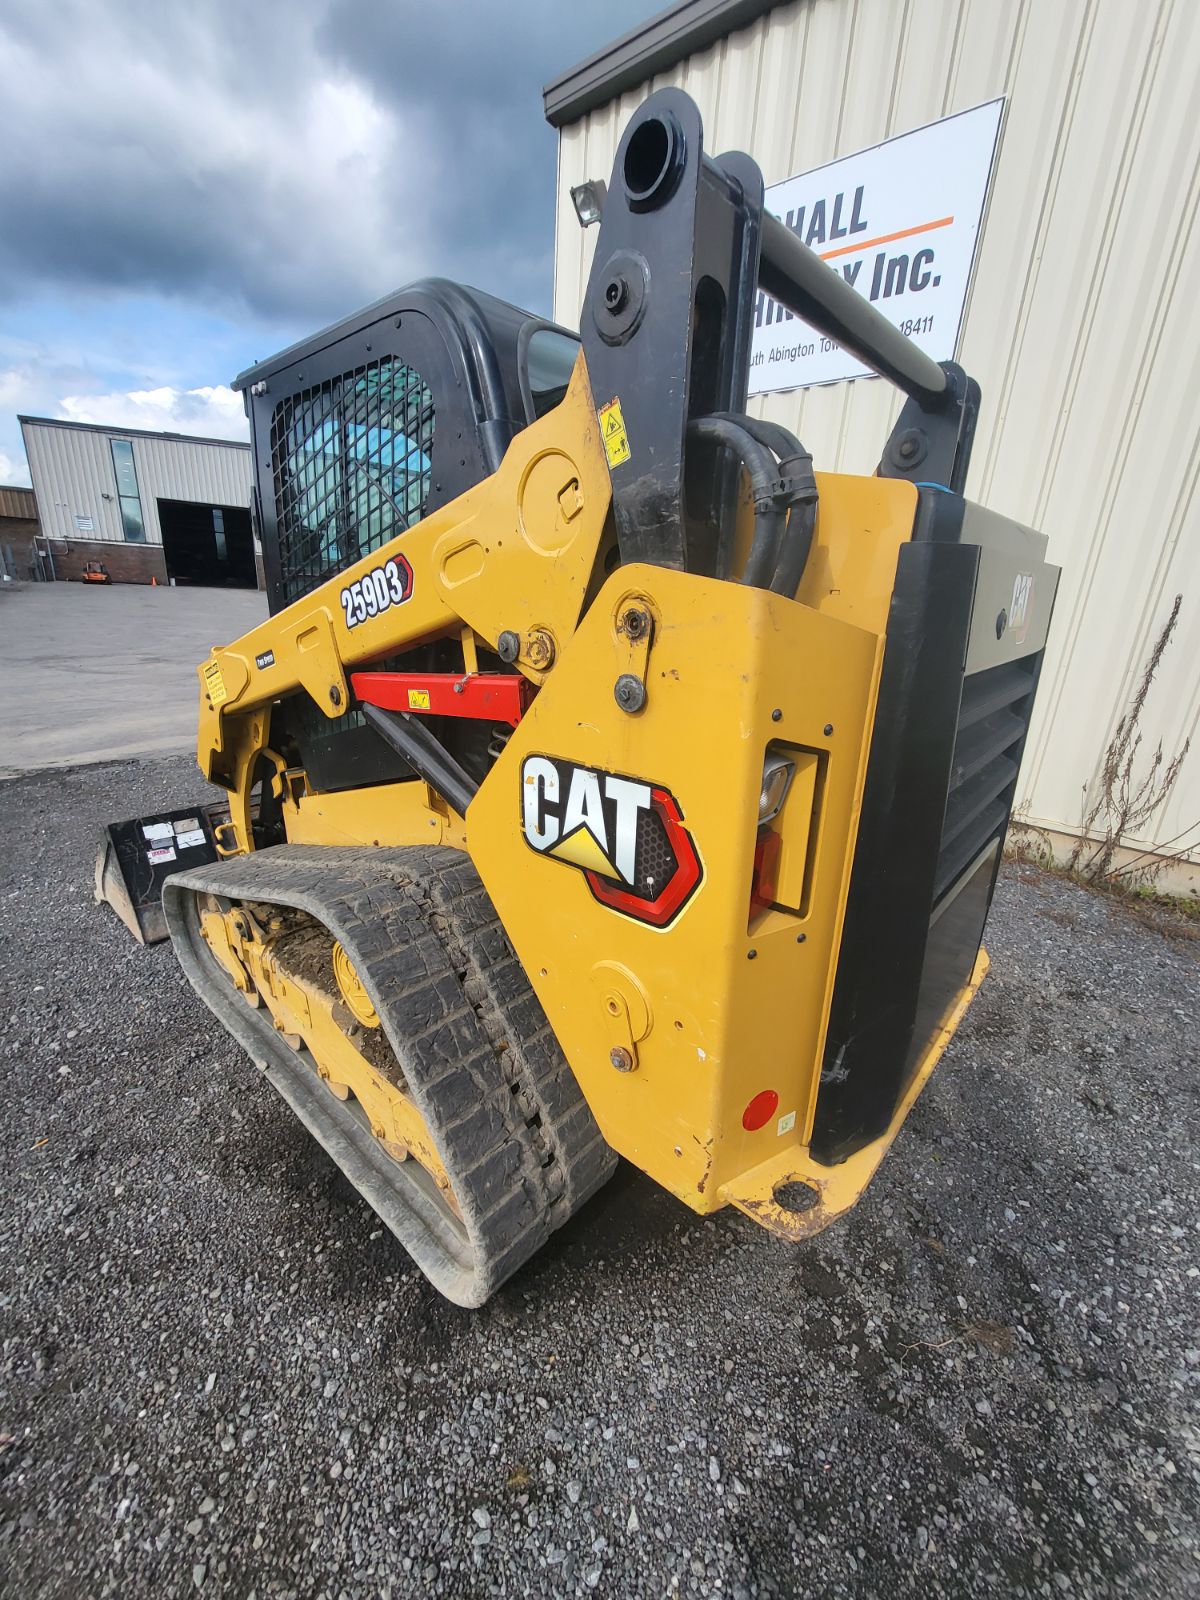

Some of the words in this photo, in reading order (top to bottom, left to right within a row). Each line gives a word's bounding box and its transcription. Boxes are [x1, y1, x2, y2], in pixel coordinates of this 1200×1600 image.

[775, 186, 868, 247] HALL
[870, 248, 942, 302] Inc.
[768, 343, 815, 363] Abington
[899, 315, 934, 337] 18411
[341, 561, 403, 628] 259D3
[523, 756, 651, 886] CAT
